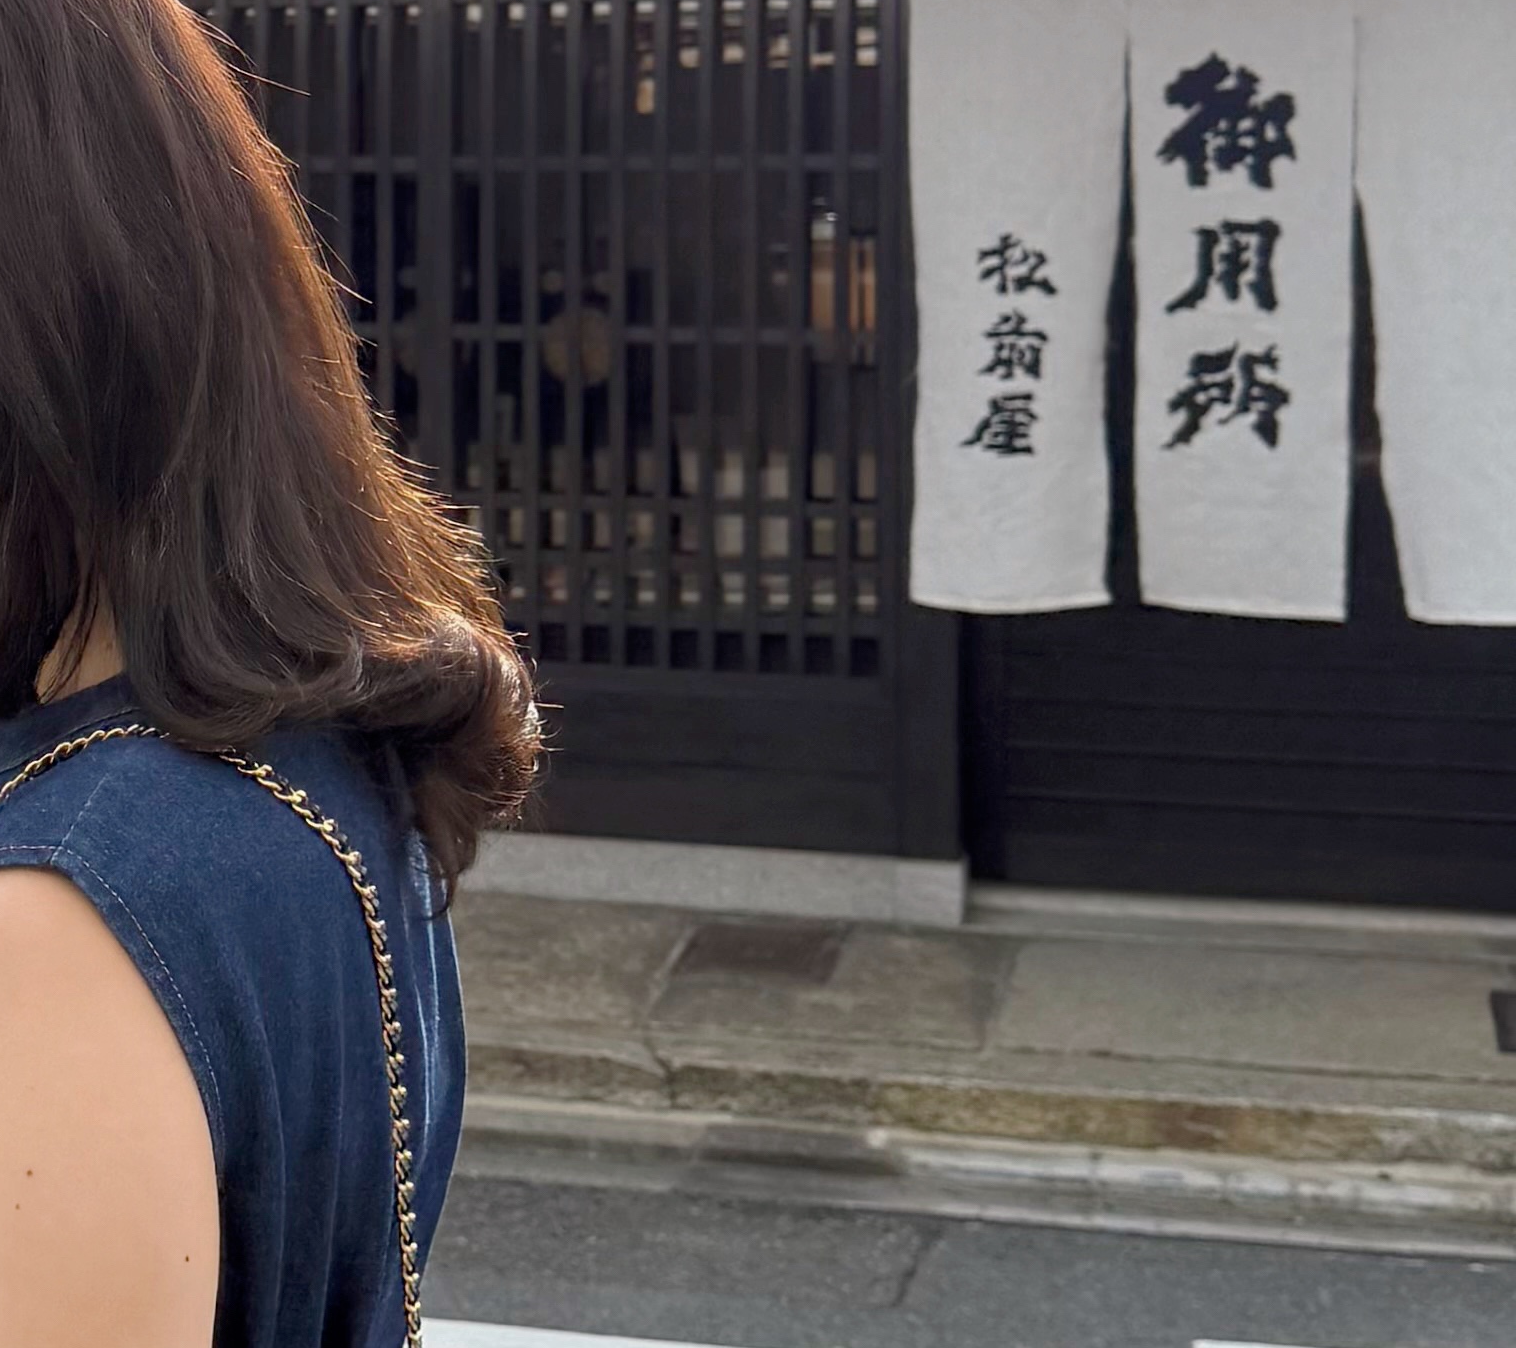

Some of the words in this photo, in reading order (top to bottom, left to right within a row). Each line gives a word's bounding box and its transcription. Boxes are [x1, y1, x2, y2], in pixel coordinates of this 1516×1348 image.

[961, 232, 1059, 456] 松前屋
[1155, 51, 1298, 450] 御用所
